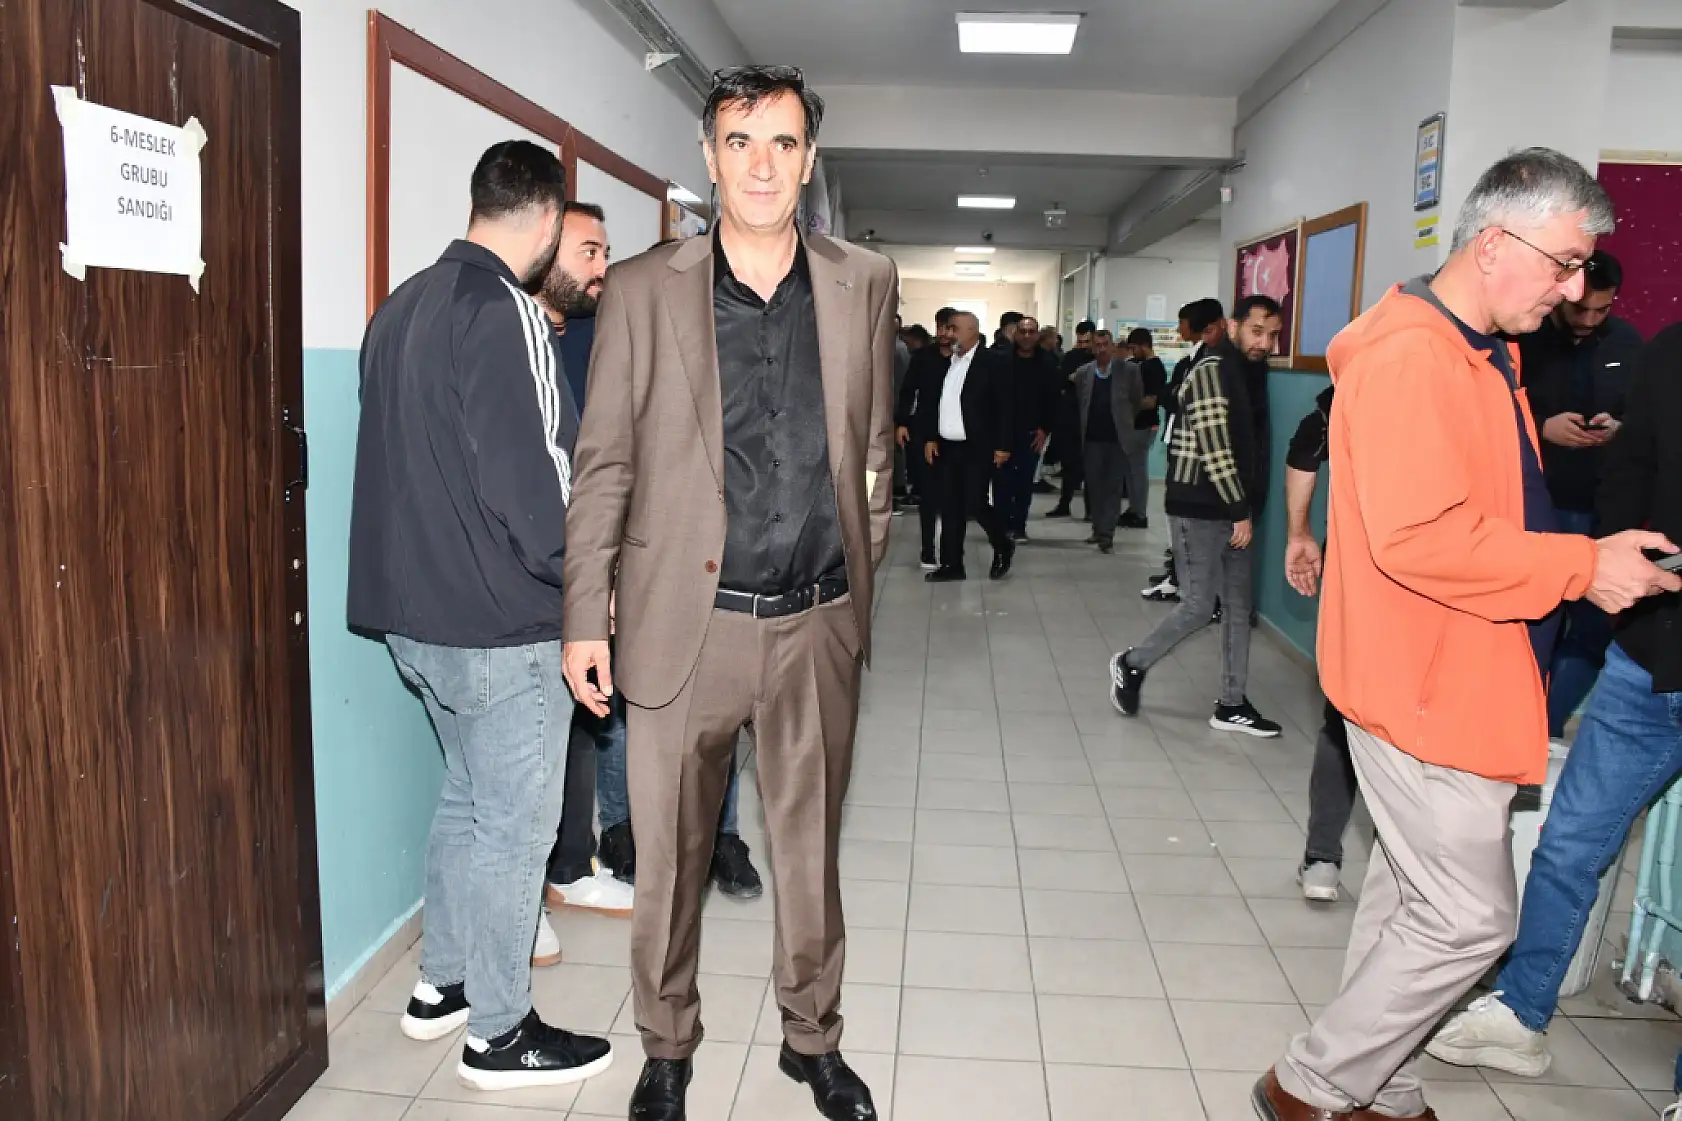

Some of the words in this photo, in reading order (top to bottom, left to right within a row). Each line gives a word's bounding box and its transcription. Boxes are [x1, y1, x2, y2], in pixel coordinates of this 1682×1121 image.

[110, 125, 176, 157] 6-MESLEK
[120, 163, 168, 188] GRUBU
[117, 196, 173, 222] SANDIĞI
